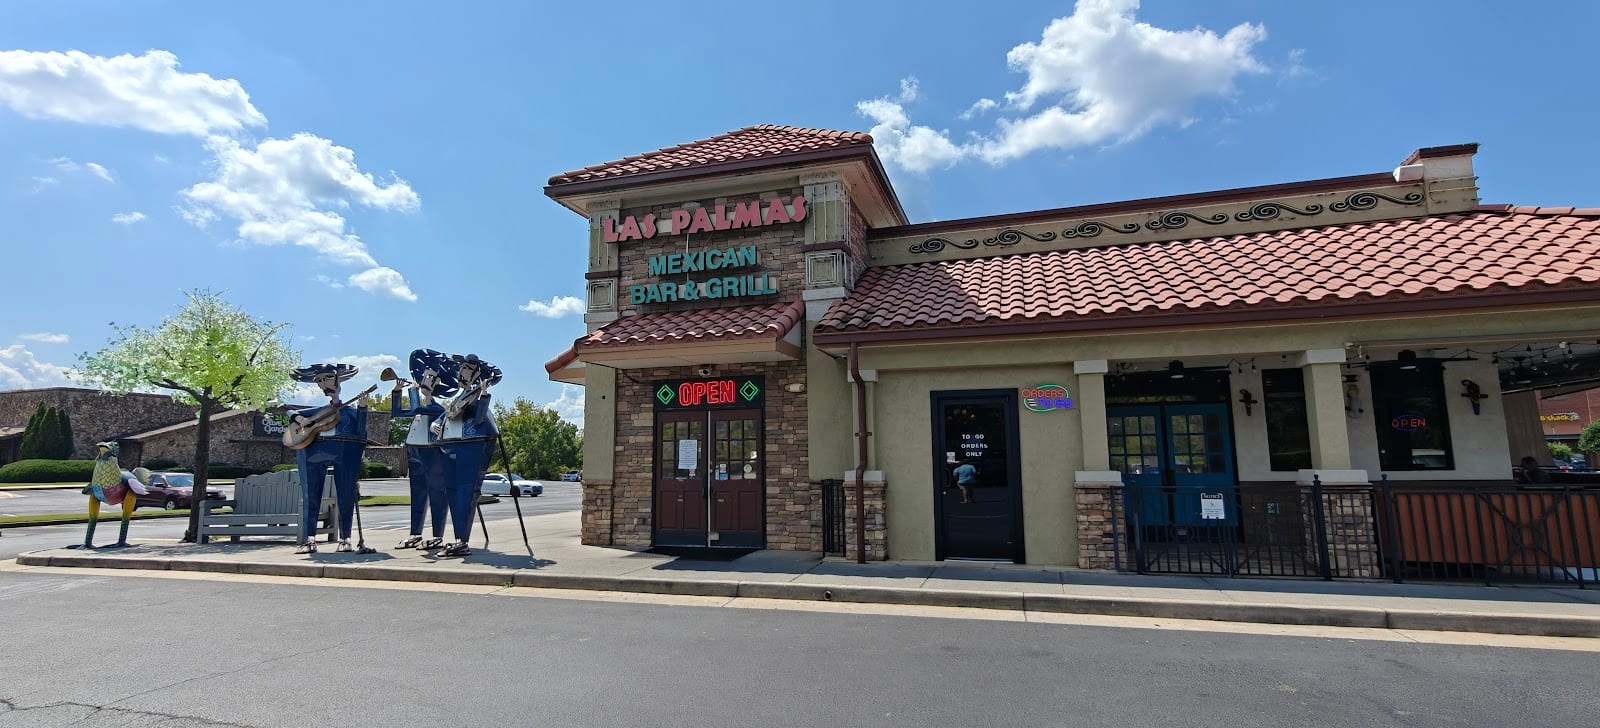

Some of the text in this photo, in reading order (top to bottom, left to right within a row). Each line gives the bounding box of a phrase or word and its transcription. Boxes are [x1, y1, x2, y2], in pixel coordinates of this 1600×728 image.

[603, 195, 807, 243] LAS PALMAS
[649, 245, 757, 276] MEXICAN
[631, 273, 777, 304] BAR & GRILL
[679, 380, 736, 406] OPEN
[1021, 388, 1064, 398] ORDERS
[1038, 397, 1073, 408] TO GO
[1391, 418, 1426, 428] OPEN
